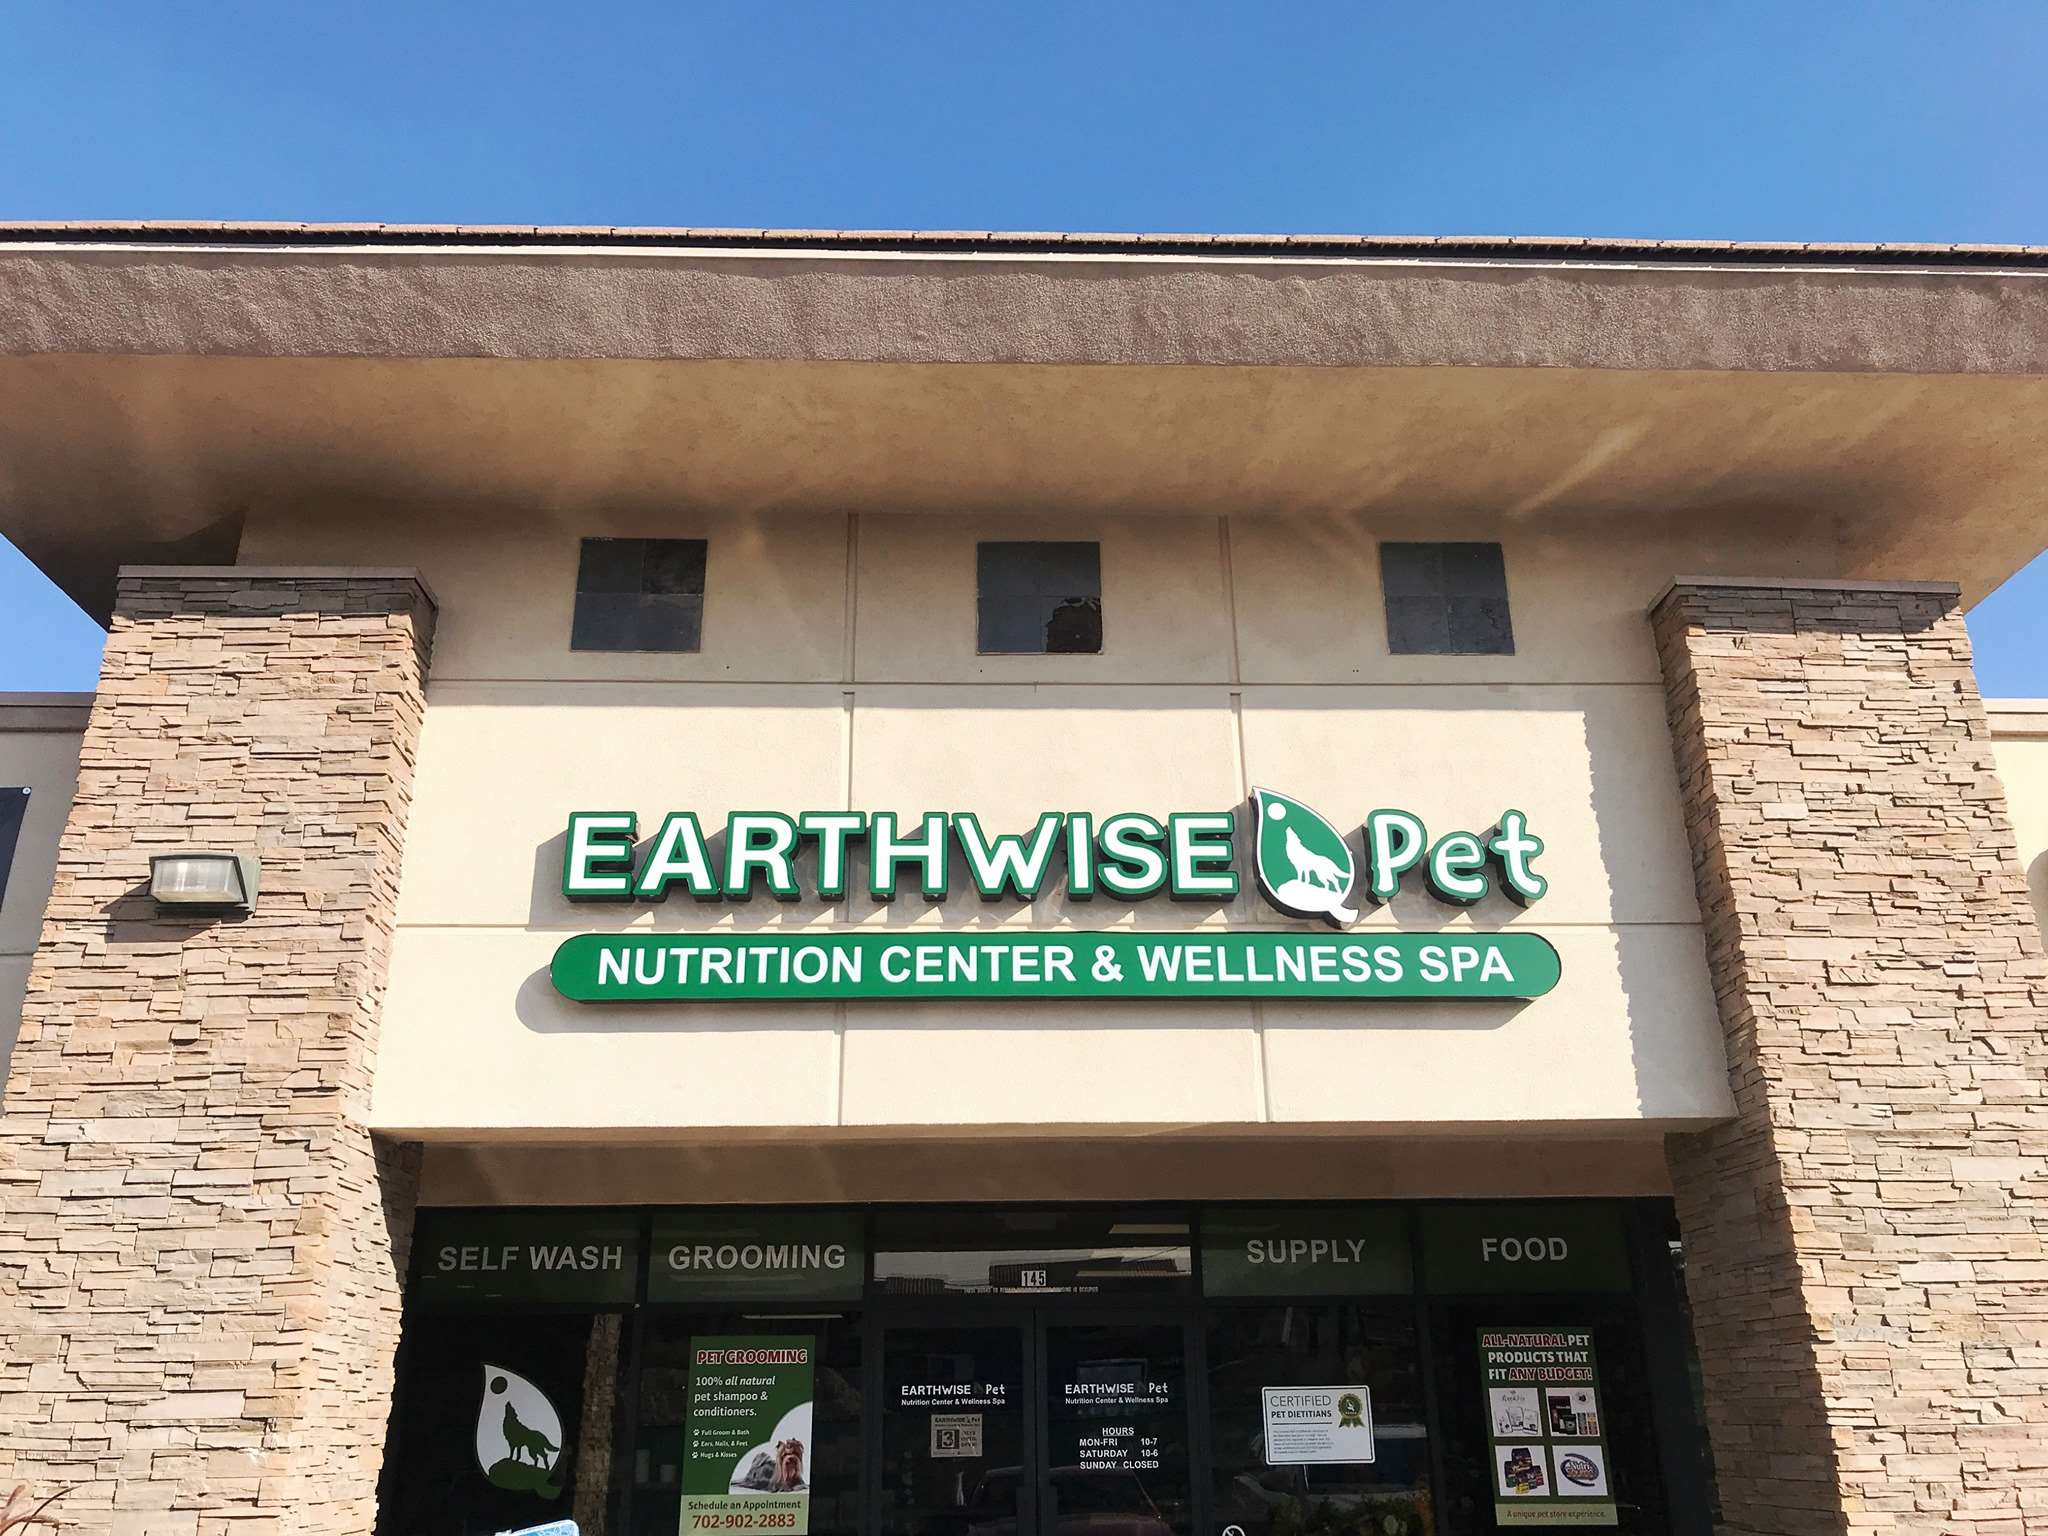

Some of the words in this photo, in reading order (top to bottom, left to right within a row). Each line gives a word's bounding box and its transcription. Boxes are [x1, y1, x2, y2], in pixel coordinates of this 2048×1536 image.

[562, 811, 1240, 898] EARTHWISE
[1366, 809, 1548, 902] Pet
[598, 946, 862, 985] NUTRITION
[879, 945, 1077, 983] CENTER
[1091, 945, 1124, 982] &
[1137, 945, 1404, 982] WELLNESS
[1419, 945, 1515, 982] SPA
[1246, 1239, 1365, 1264] SUPPLY
[1481, 1237, 1568, 1261] FOOD
[438, 1246, 519, 1271] SELF
[529, 1245, 623, 1270] WASH
[668, 1244, 846, 1270] GROOMING
[1023, 1271, 1045, 1286] 145
[1482, 1334, 1567, 1348] ALL-NATURAL
[1568, 1335, 1589, 1347] PET
[697, 1350, 725, 1365] PET
[726, 1349, 807, 1365] GROOMING
[1488, 1351, 1555, 1363] PRODUCTS
[1557, 1351, 1588, 1363] THAT
[695, 1376, 723, 1387] 100%
[725, 1376, 737, 1387] all
[740, 1375, 775, 1387] natural
[1489, 1369, 1507, 1380] FIT
[1509, 1368, 1537, 1381] ANY
[1538, 1368, 1593, 1381] BUDGET!
[901, 1384, 971, 1396] EARTHWISE
[985, 1383, 1005, 1395] Pet
[1065, 1383, 1134, 1395] EARTHWISE
[1148, 1382, 1168, 1394] Pet
[694, 1391, 710, 1404] pet
[713, 1391, 758, 1403] shampoo
[760, 1391, 768, 1401] &
[932, 1398, 953, 1406] Center
[991, 1397, 1005, 1406] Spa
[1065, 1397, 1094, 1405] Nutrition
[1118, 1396, 1123, 1404] &
[1124, 1396, 1154, 1404] Wellness
[1155, 1396, 1169, 1404] Spa
[1271, 1395, 1332, 1407] CERTIFIED
[693, 1406, 757, 1418] conditioners.
[1288, 1410, 1332, 1418] DIETITIANS
[1102, 1427, 1135, 1436] HOURS
[1079, 1438, 1118, 1447] MON-FRI
[1140, 1437, 1158, 1446] 10-7
[1079, 1449, 1128, 1458] SATURDAY
[1141, 1449, 1159, 1458] 10-6
[1080, 1461, 1117, 1469] SUNDAY
[1122, 1460, 1159, 1469] CLOSED
[688, 1500, 727, 1511] Schedule
[729, 1501, 741, 1510] an
[743, 1499, 801, 1513] Appointment
[692, 1514, 795, 1529] 702-902-2883
[1513, 1511, 1536, 1520] unique
